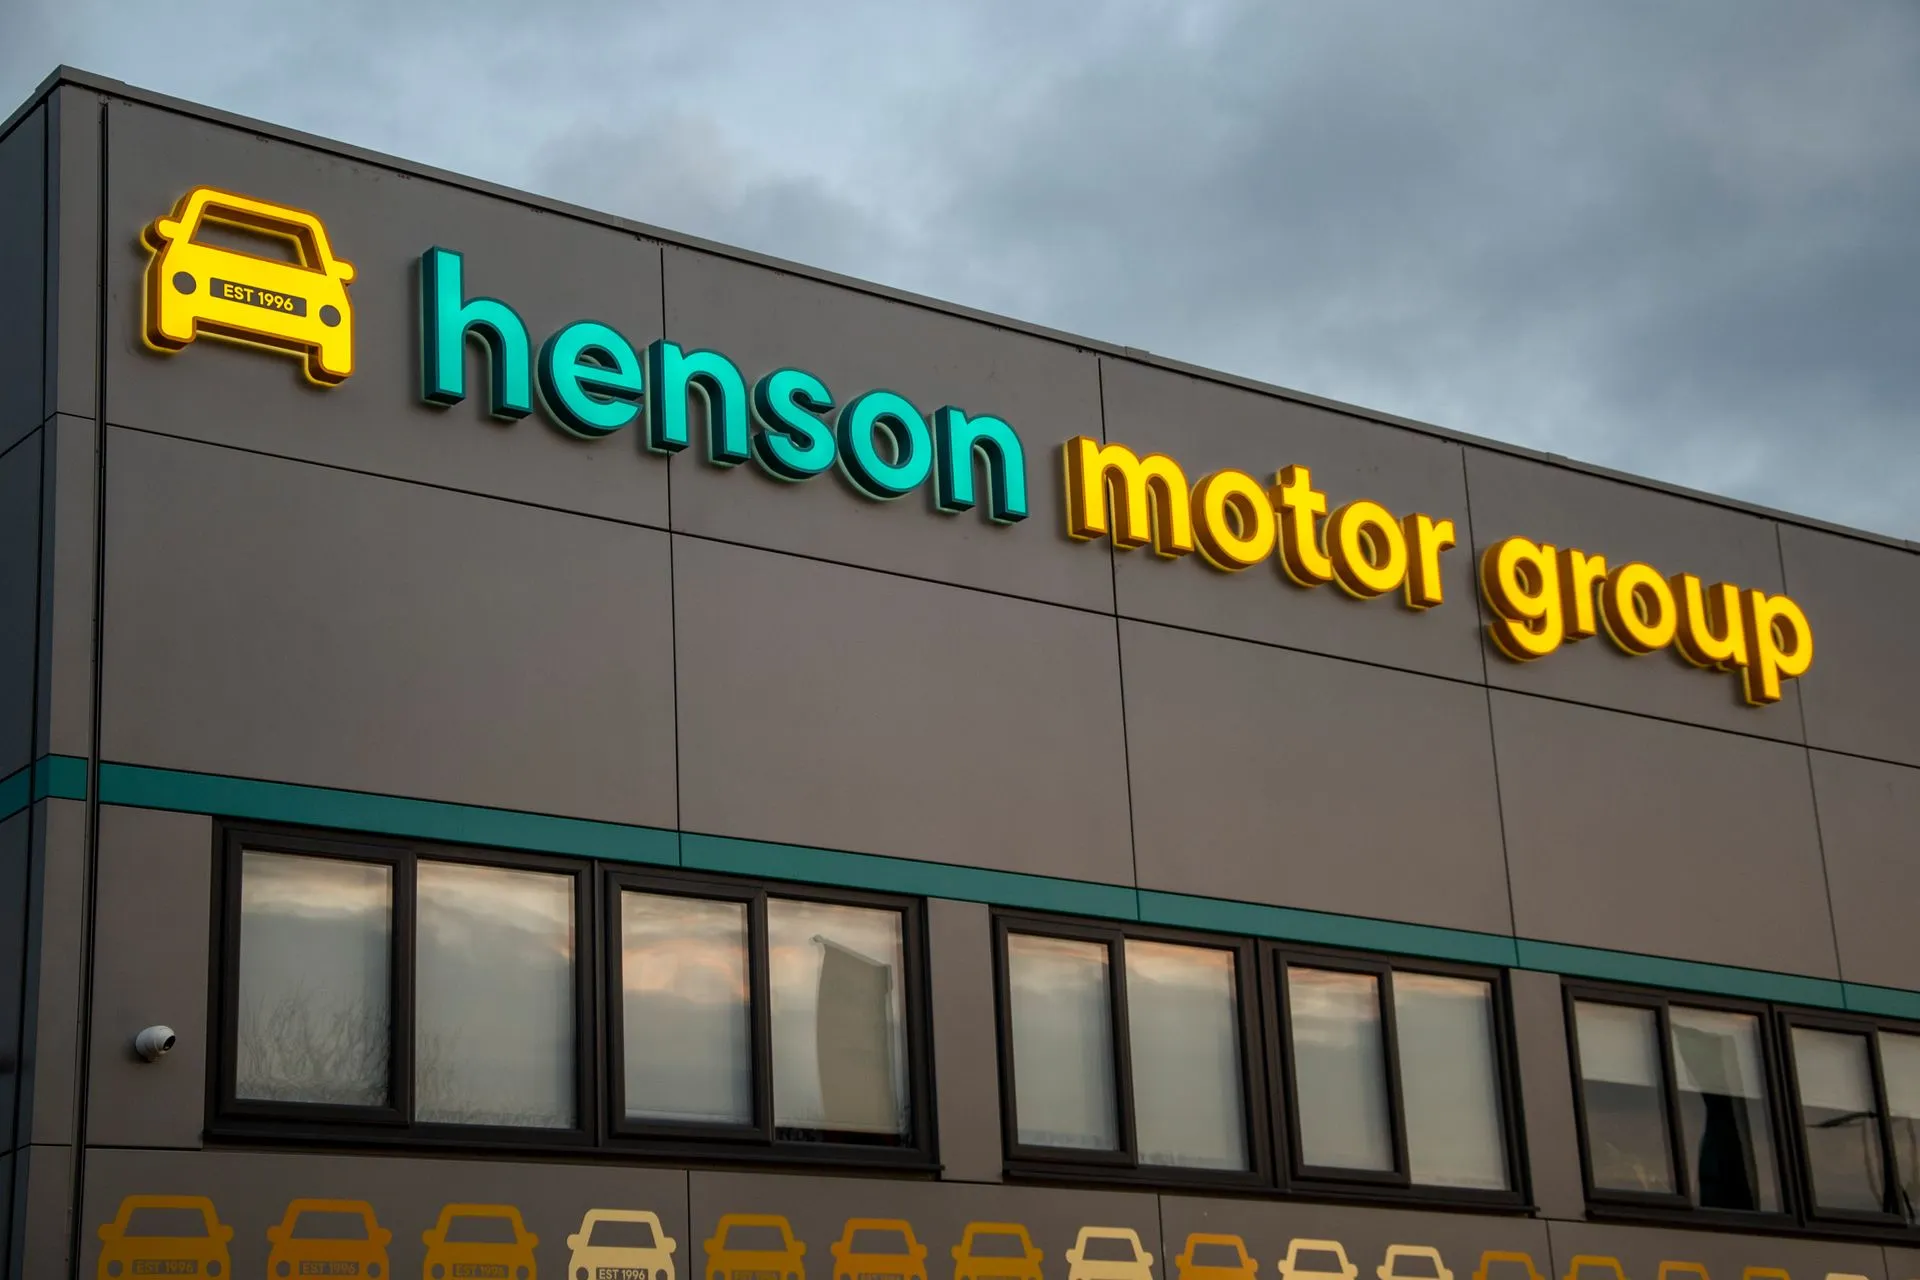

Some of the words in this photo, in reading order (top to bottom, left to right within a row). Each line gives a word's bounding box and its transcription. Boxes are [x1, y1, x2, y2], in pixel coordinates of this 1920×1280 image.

[223, 283, 254, 302] EST
[258, 292, 294, 311] 1996
[421, 245, 1029, 522] henson
[1065, 434, 1456, 608] motor
[1481, 535, 1813, 705] group
[136, 1261, 161, 1273] EST
[165, 1261, 194, 1274] 1996
[303, 1263, 324, 1274] EST
[599, 1269, 619, 1280] EST
[622, 1270, 645, 1280] 1996
